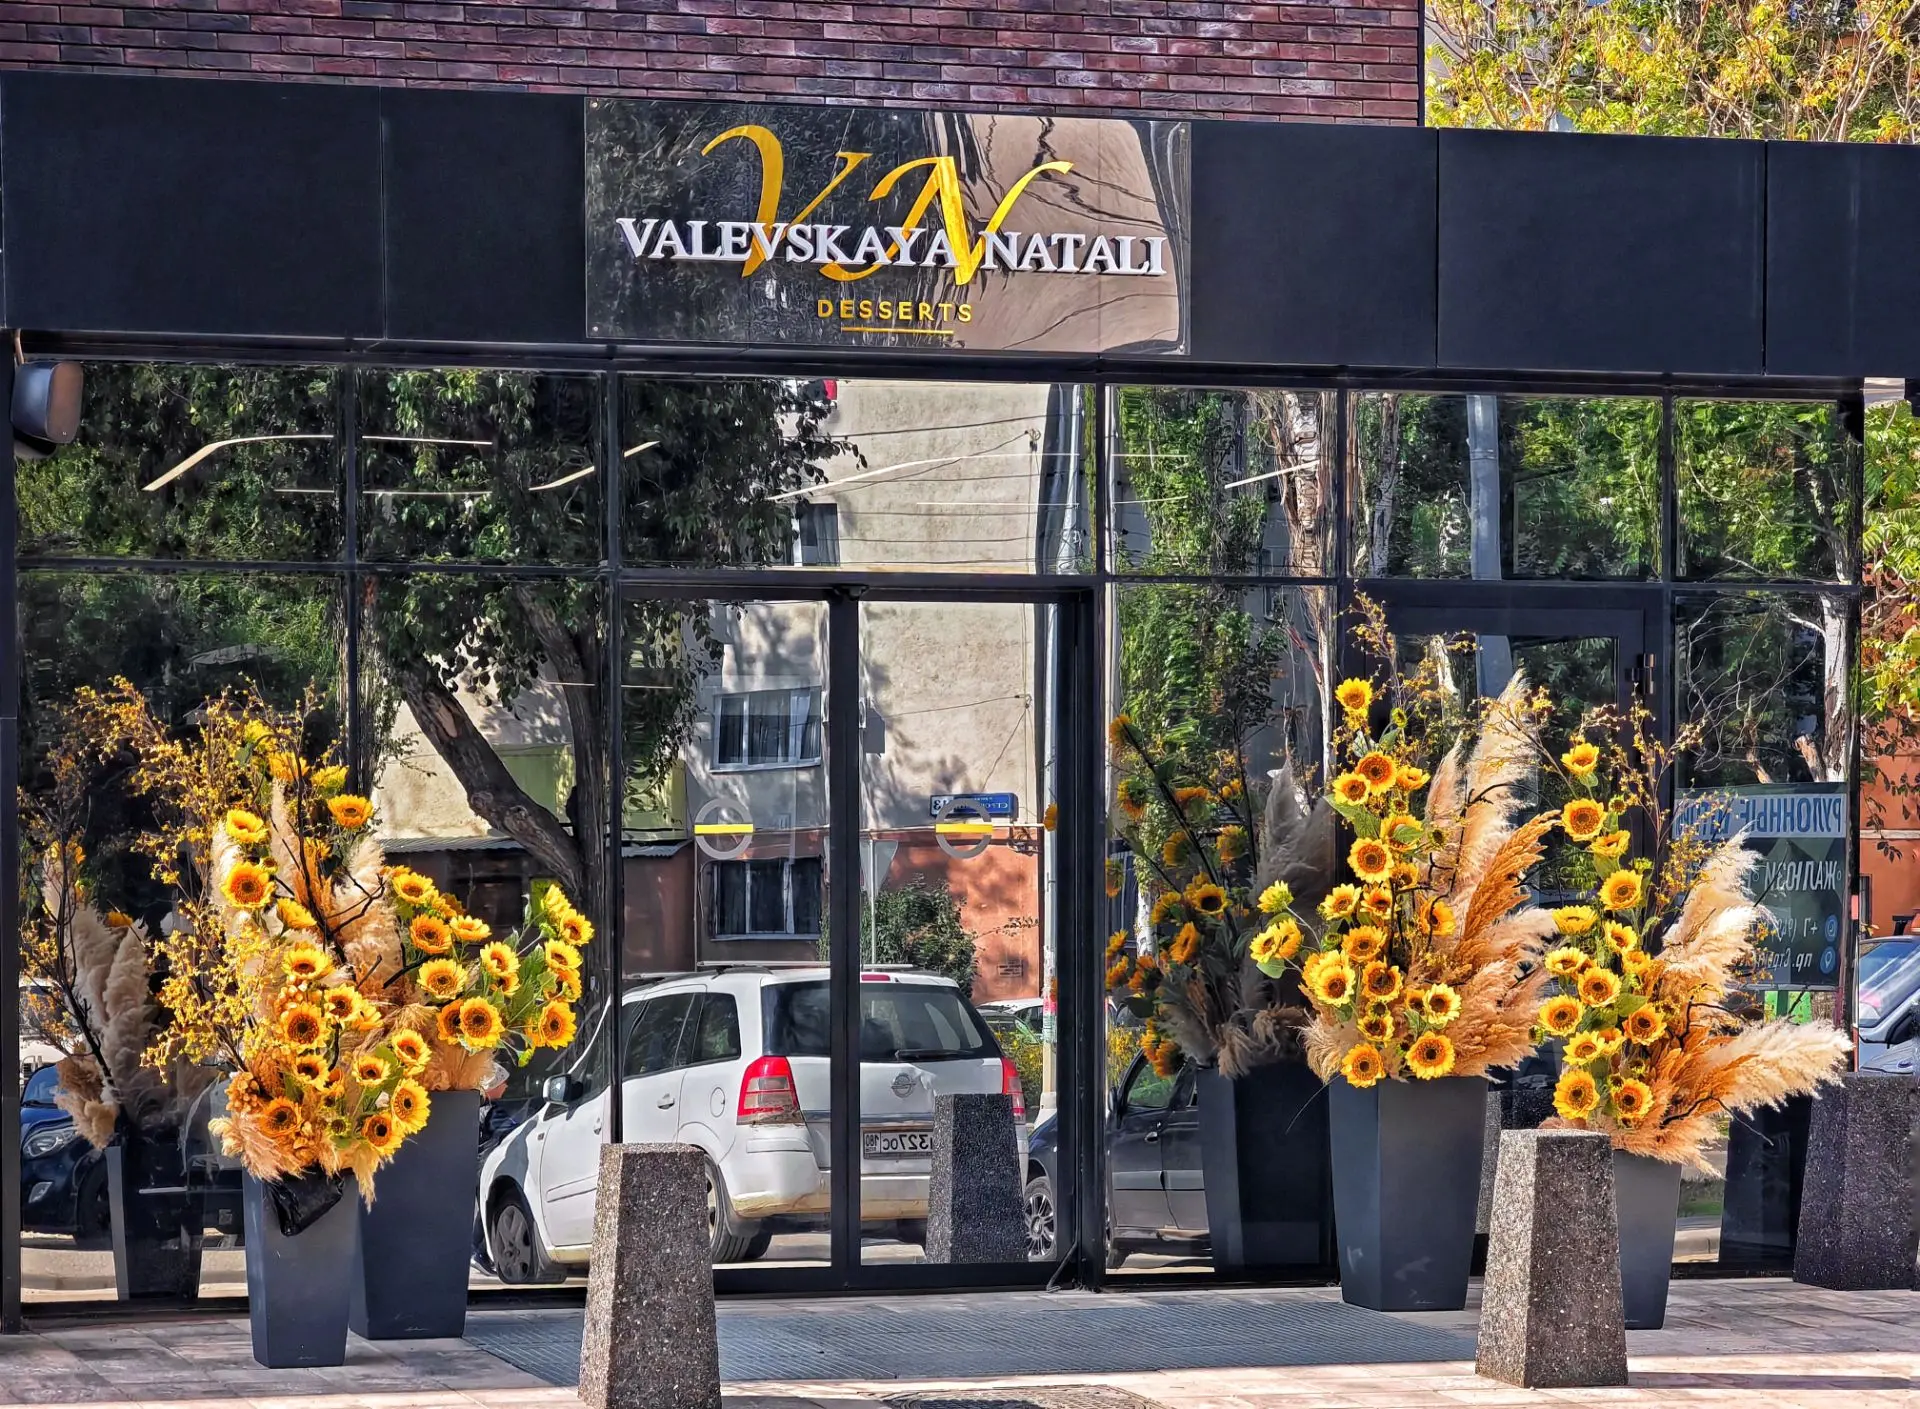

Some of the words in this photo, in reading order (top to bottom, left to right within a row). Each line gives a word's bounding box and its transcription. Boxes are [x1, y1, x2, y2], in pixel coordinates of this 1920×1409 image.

[616, 217, 959, 268] VALEVSKAYA
[979, 231, 1168, 276] NATALI
[818, 299, 972, 323] DESSERTS
